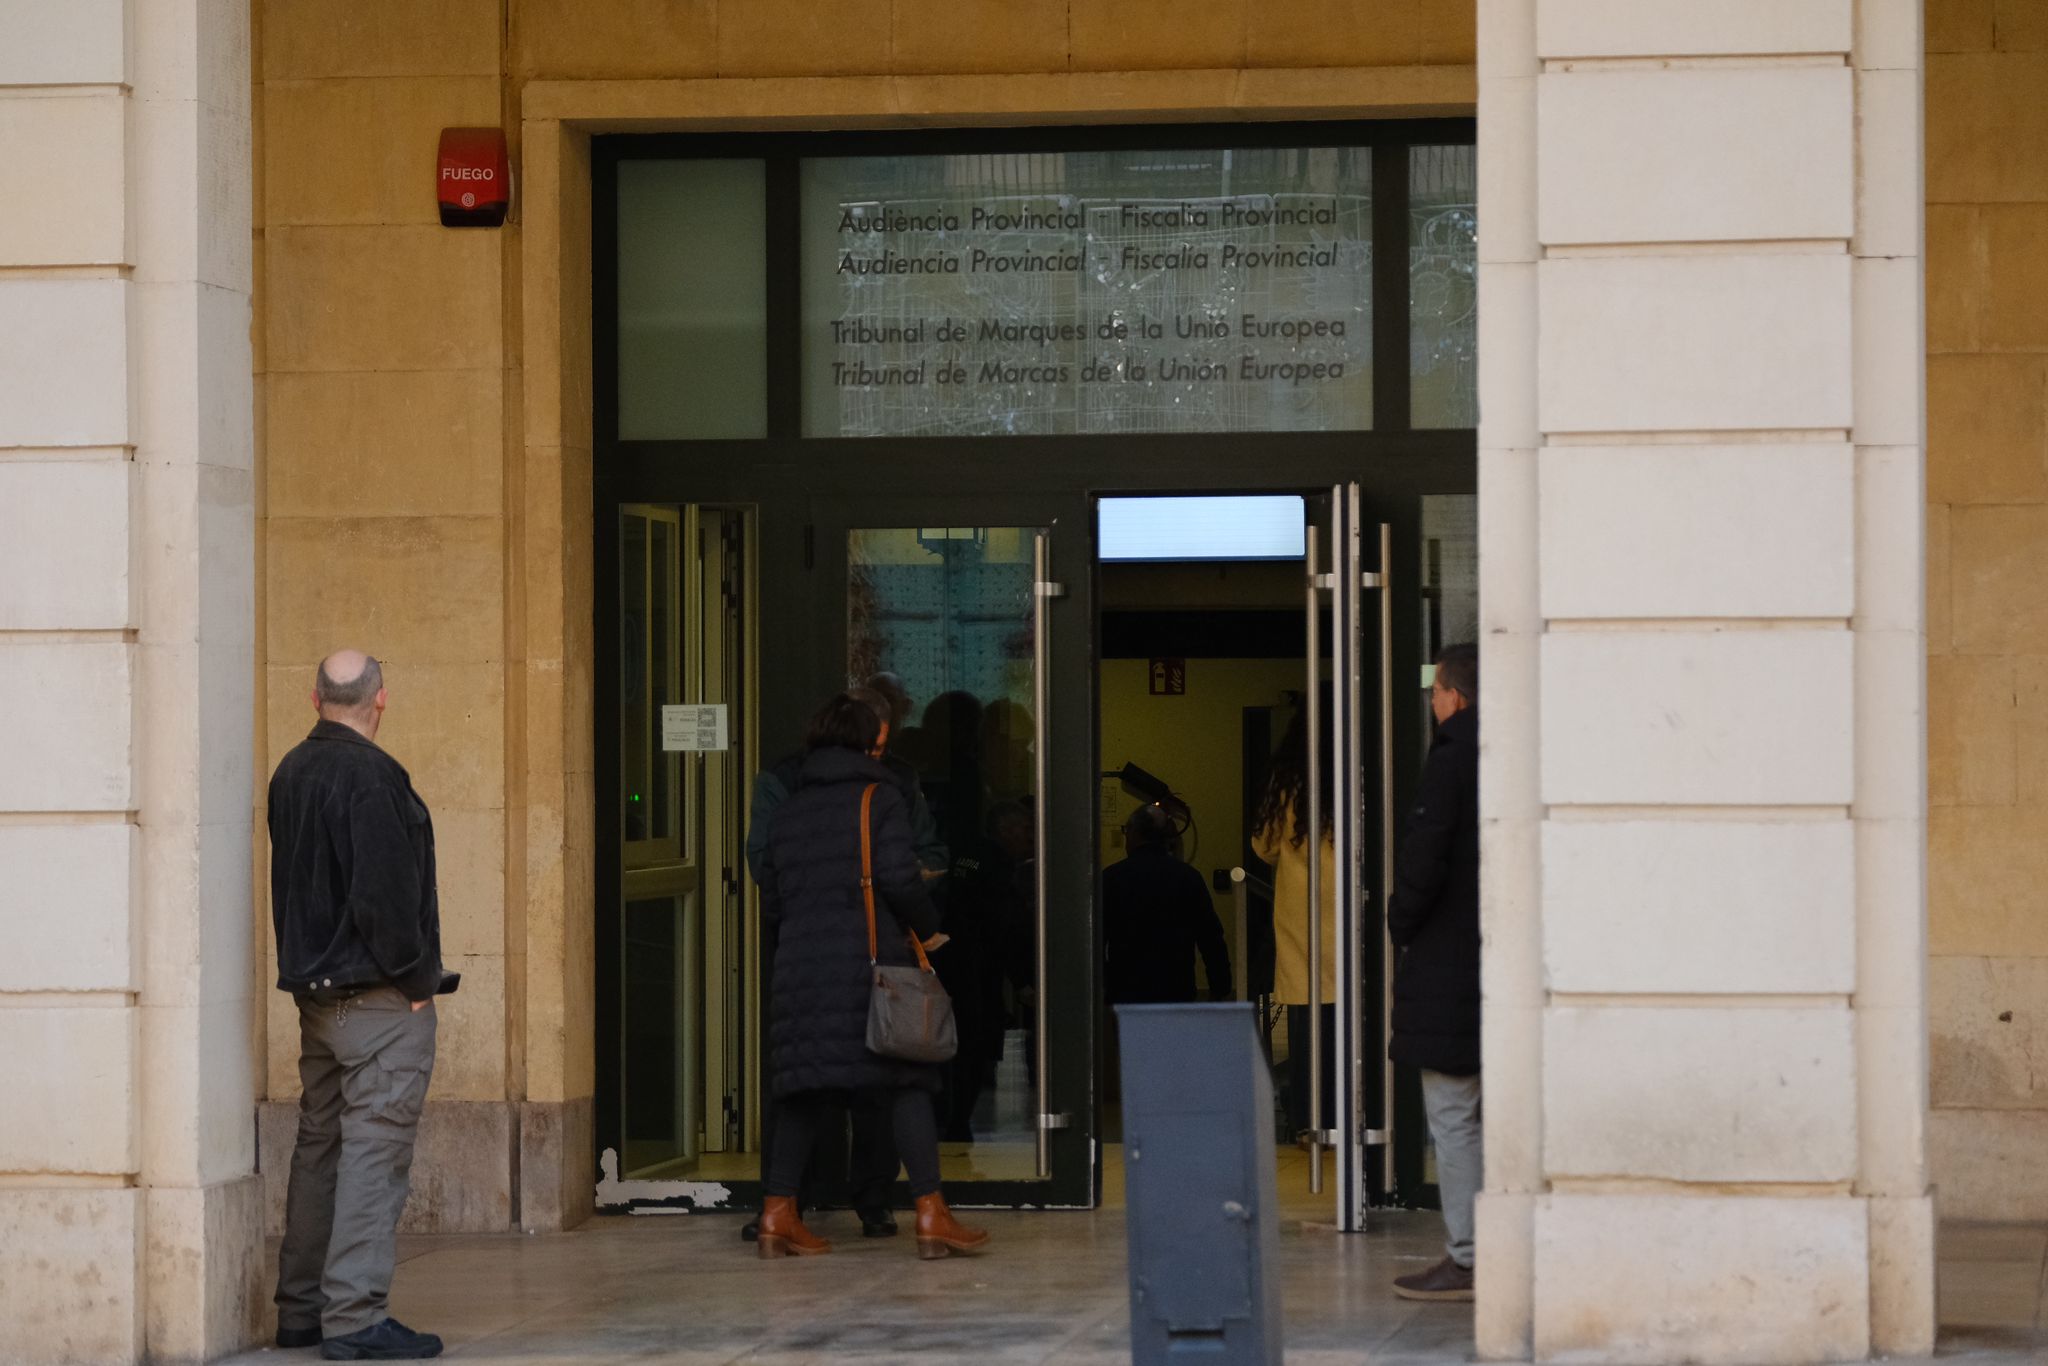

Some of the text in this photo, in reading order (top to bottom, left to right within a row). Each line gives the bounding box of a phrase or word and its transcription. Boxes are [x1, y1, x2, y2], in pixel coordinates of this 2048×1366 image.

[443, 168, 494, 180] FUEGO
[838, 207, 960, 232] Audiència
[972, 204, 1086, 230] Provincial
[1222, 200, 1337, 226] Provincial
[837, 249, 960, 275] Audiencia
[971, 246, 1087, 272] Provincial
[1121, 246, 1209, 270] Fiscalía
[1221, 242, 1338, 268] Provincial
[830, 314, 1346, 347] Tribunal de Marques de la Unió Europea
[831, 356, 1345, 386] Tribunal de Marcas de la Unión Europea
